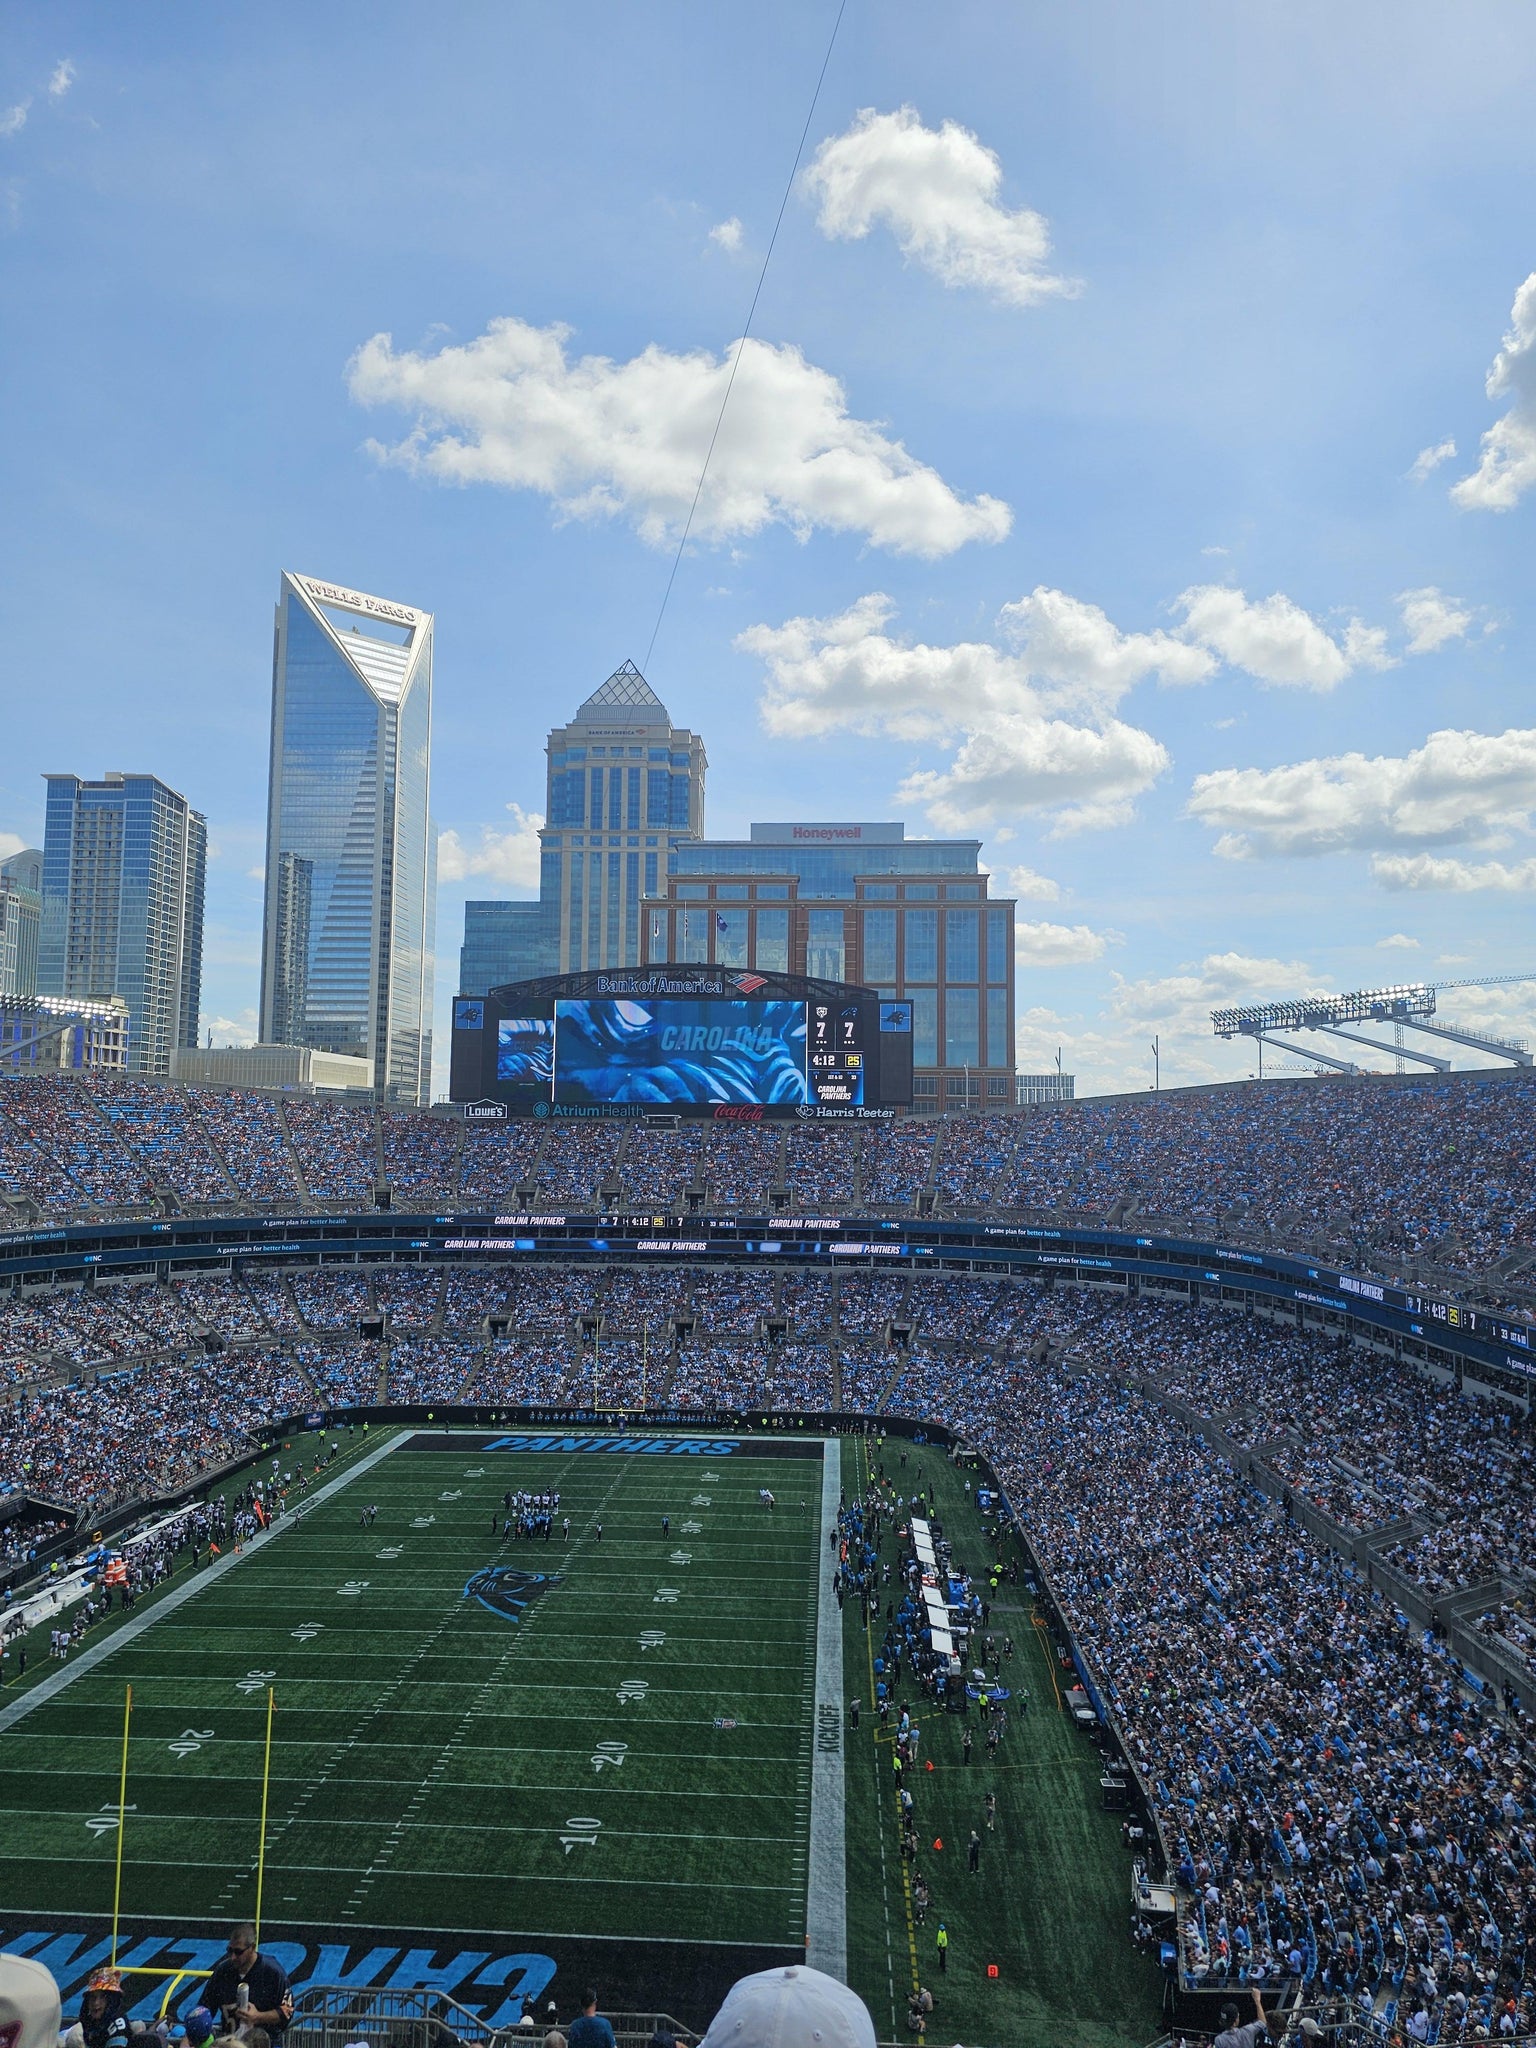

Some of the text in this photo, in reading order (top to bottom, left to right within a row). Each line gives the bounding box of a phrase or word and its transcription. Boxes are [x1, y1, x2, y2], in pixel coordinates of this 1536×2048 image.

[306, 581, 416, 622] WELLS FARGO
[793, 827, 861, 840] Honeywell
[597, 976, 723, 994] Bank of America
[816, 1022, 826, 1038] 7
[844, 1022, 854, 1038] 7
[660, 1025, 773, 1051] CAROLINA
[812, 1055, 835, 1066] 4:12
[847, 1056, 860, 1066] 25
[817, 1085, 847, 1093] CAROLINA
[820, 1092, 852, 1100] PANTHERS
[552, 1104, 645, 1118] Atrium Health
[816, 1107, 895, 1118] Harris Teeter
[286, 1219, 299, 1227] plan
[494, 1216, 566, 1226] CAROLINA PANTHERS
[613, 1217, 618, 1226] 7
[632, 1217, 649, 1226] 4:12
[678, 1217, 683, 1227] 7
[768, 1219, 841, 1229] CAROLINA PANTHERS
[1005, 1228, 1017, 1236] plan
[1026, 1229, 1043, 1237] better
[1044, 1230, 1061, 1238] health
[444, 1240, 516, 1249] CAROLINA PANTHERS
[637, 1241, 707, 1251] CAROLINA PANTHERS
[863, 1245, 901, 1255] PANTHERS
[1058, 1256, 1070, 1264] plan
[1079, 1258, 1095, 1266] better
[1095, 1259, 1111, 1267] health
[1360, 1282, 1384, 1301] PANTHERS
[1417, 1298, 1421, 1313] 7
[1432, 1303, 1446, 1320] 4:12
[1470, 1312, 1476, 1330] 7
[482, 1436, 740, 1456] PANTHERS
[818, 1704, 840, 1753] KICKOFF
[590, 1741, 628, 1766] 20
[559, 1817, 602, 1846] 10
[0, 1928, 557, 2041] CARLIN
